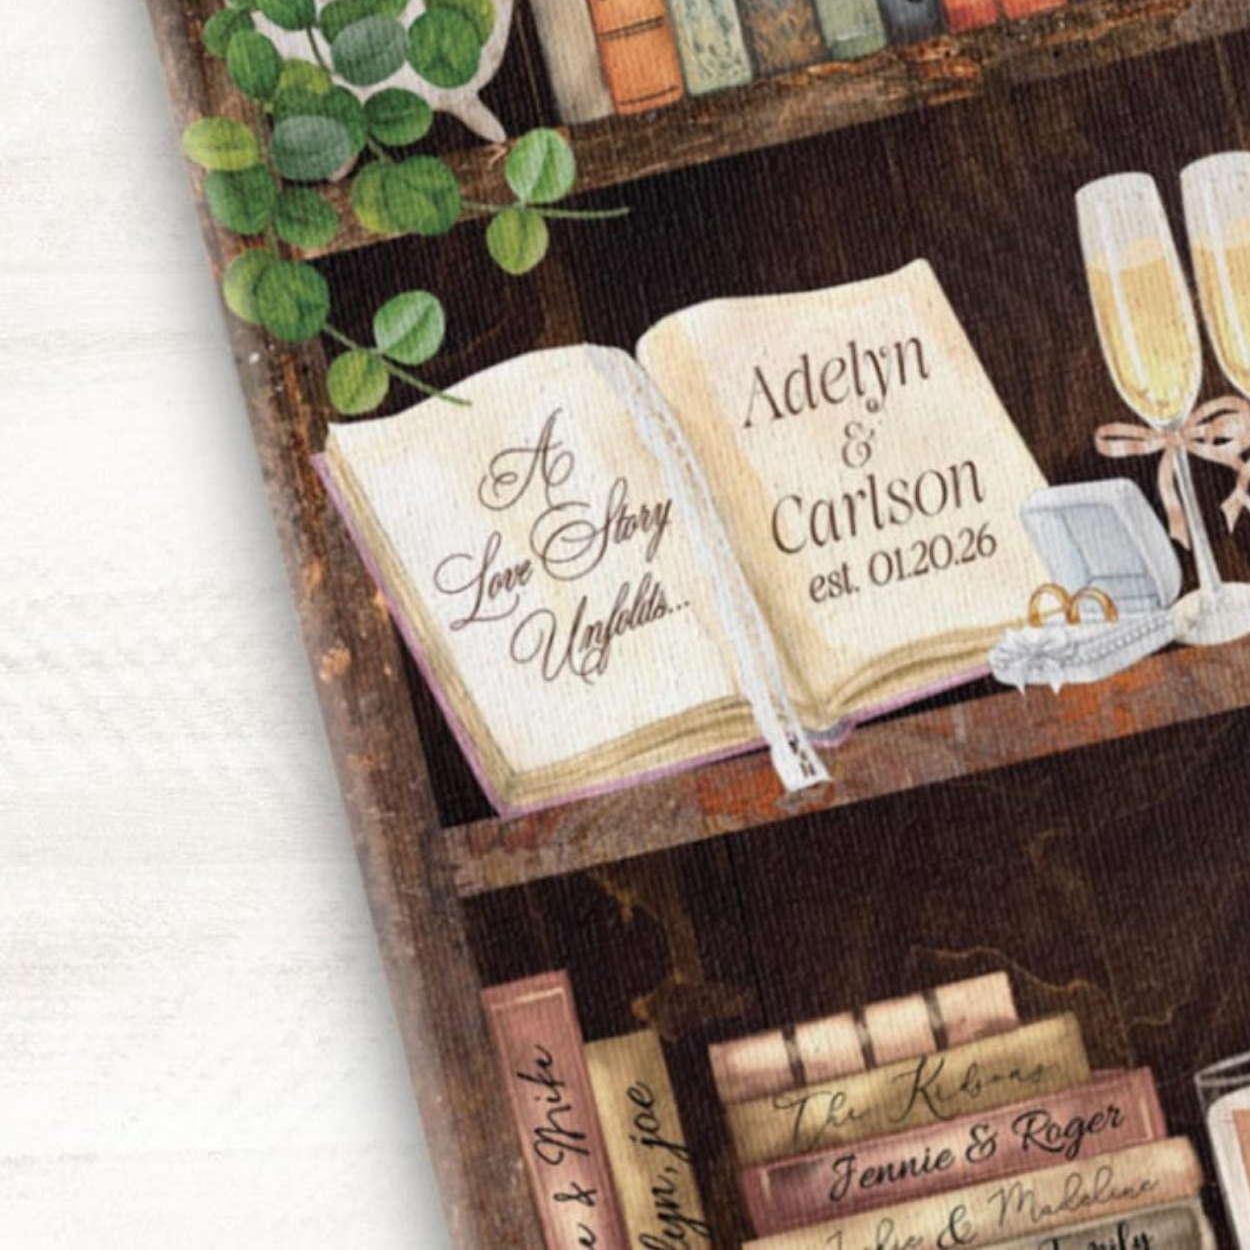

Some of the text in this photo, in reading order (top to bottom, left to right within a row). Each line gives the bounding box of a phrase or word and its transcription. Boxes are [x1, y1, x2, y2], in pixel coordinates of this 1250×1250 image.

[741, 333, 931, 429] Adelyn
[477, 407, 576, 511] A
[840, 421, 876, 470] &
[433, 478, 674, 631] Love Story
[771, 458, 987, 556] Carlson
[807, 530, 998, 604] est. 01.20.26
[509, 573, 692, 685] Unfolds...
[517, 1043, 598, 1208] Mike &
[625, 1080, 694, 1164] joe
[772, 1091, 868, 1150] The
[829, 1108, 1125, 1203] Jennie & Roger
[935, 1203, 978, 1250] &
[986, 1165, 1162, 1224] Madeline
